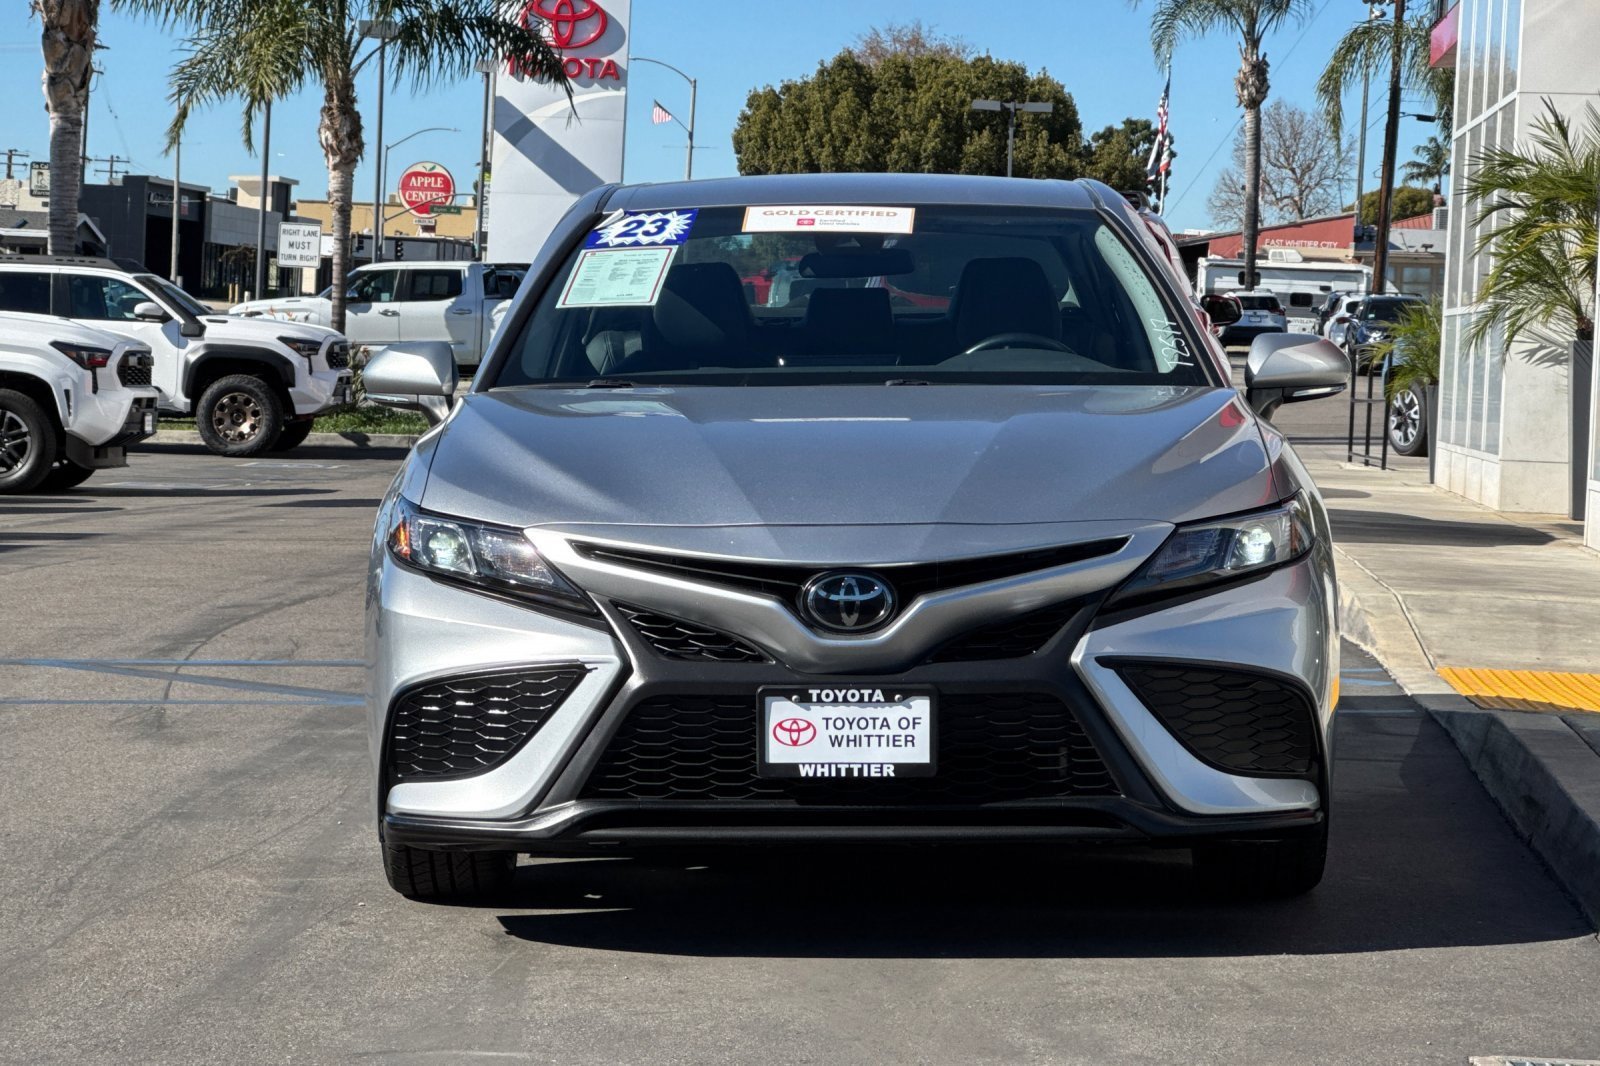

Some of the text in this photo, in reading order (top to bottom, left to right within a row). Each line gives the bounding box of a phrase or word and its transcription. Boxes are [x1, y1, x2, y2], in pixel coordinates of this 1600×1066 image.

[504, 54, 620, 80] TOTA
[409, 176, 445, 188] APPLE
[405, 190, 446, 203] CENTER
[762, 209, 811, 217] GOLD
[281, 228, 319, 238] RIGHT LANE
[614, 218, 671, 238] 23
[288, 240, 312, 250] MUST
[1264, 239, 1338, 249] EAST WHITTIER CITY
[280, 253, 318, 262] TURN RIGHT
[808, 689, 885, 702] TOYOTA
[822, 716, 922, 731] TOYOTA OF
[829, 734, 916, 748] WHITTIER
[798, 764, 896, 777] WHITTIER
